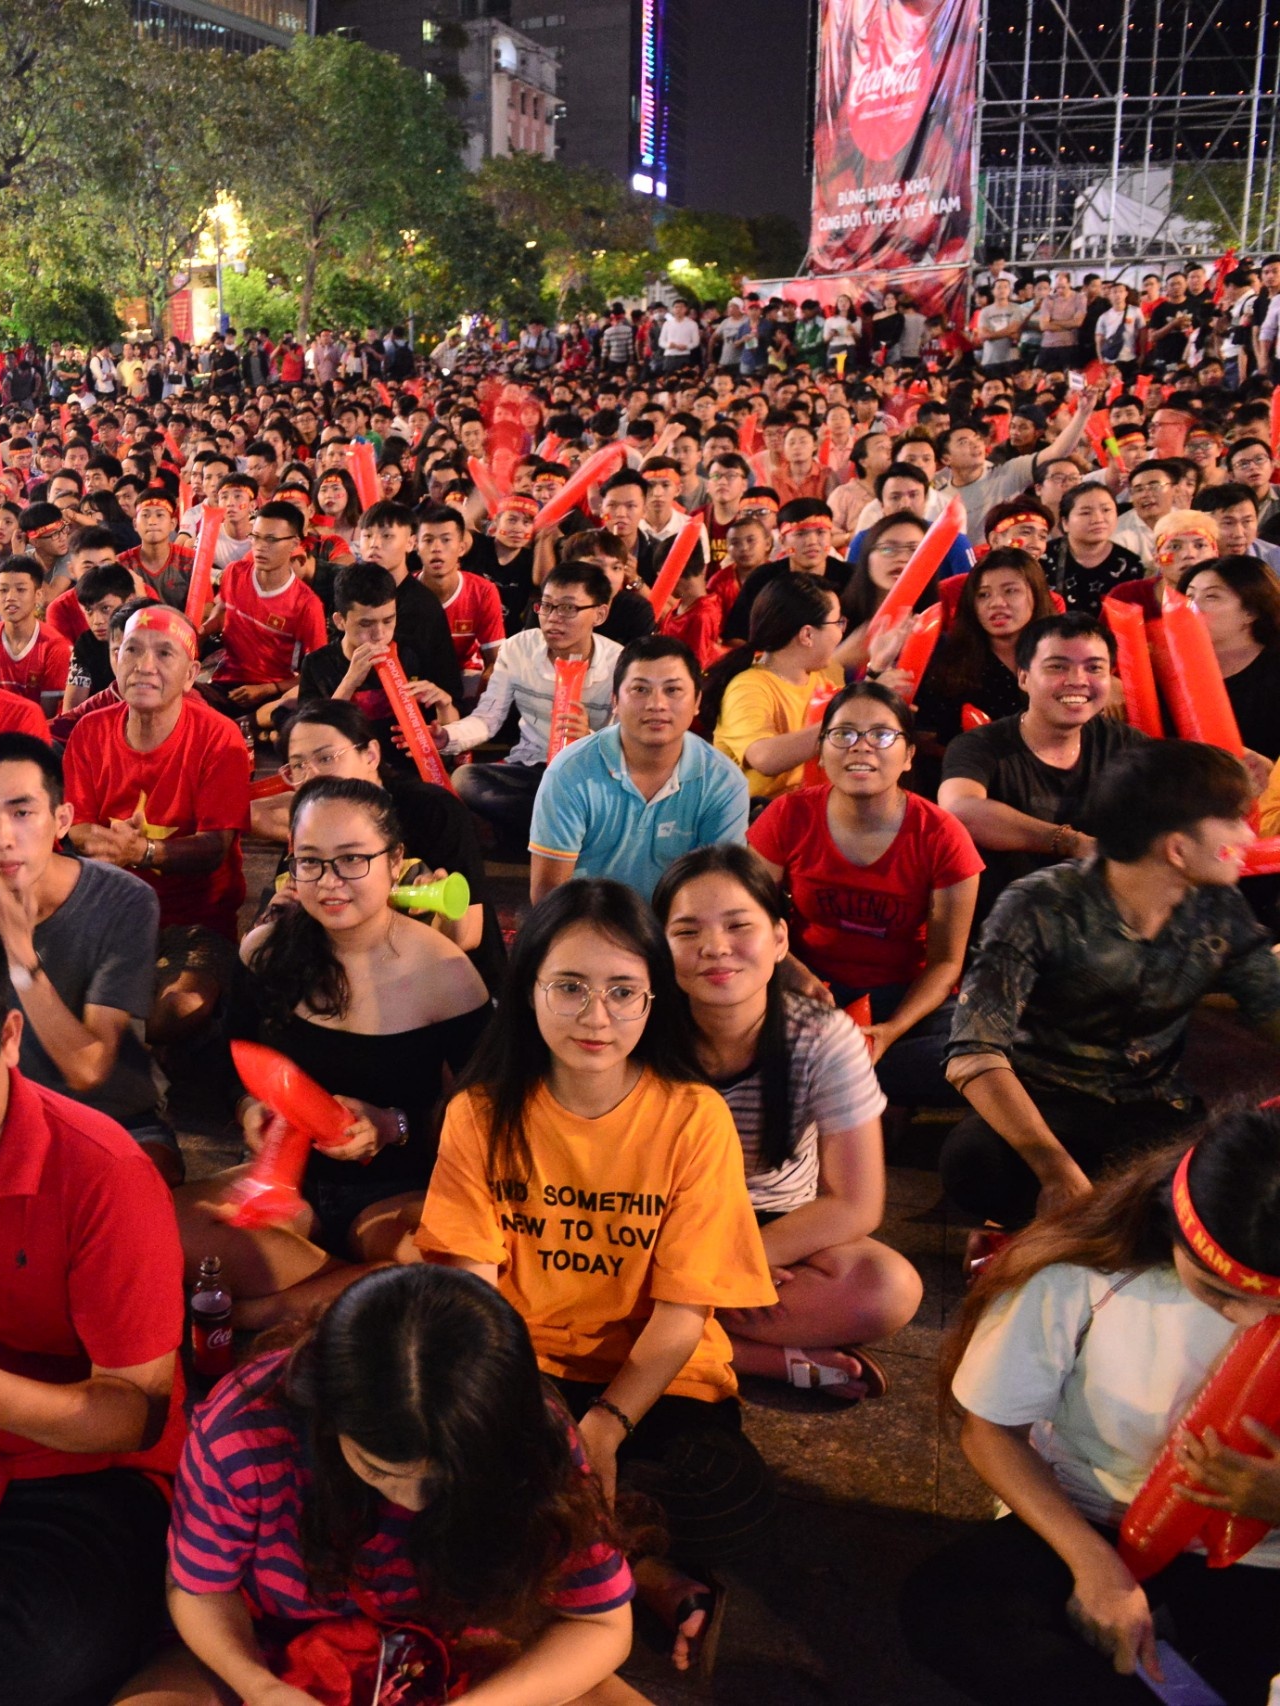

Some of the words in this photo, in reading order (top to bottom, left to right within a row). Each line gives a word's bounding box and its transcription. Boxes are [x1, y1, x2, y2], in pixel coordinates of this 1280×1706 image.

[929, 196, 961, 215] NAM
[500, 1212, 546, 1239] NEW
[560, 1218, 593, 1241] TO
[537, 1249, 624, 1278] TODAY
[1192, 1230, 1232, 1275] NAM
